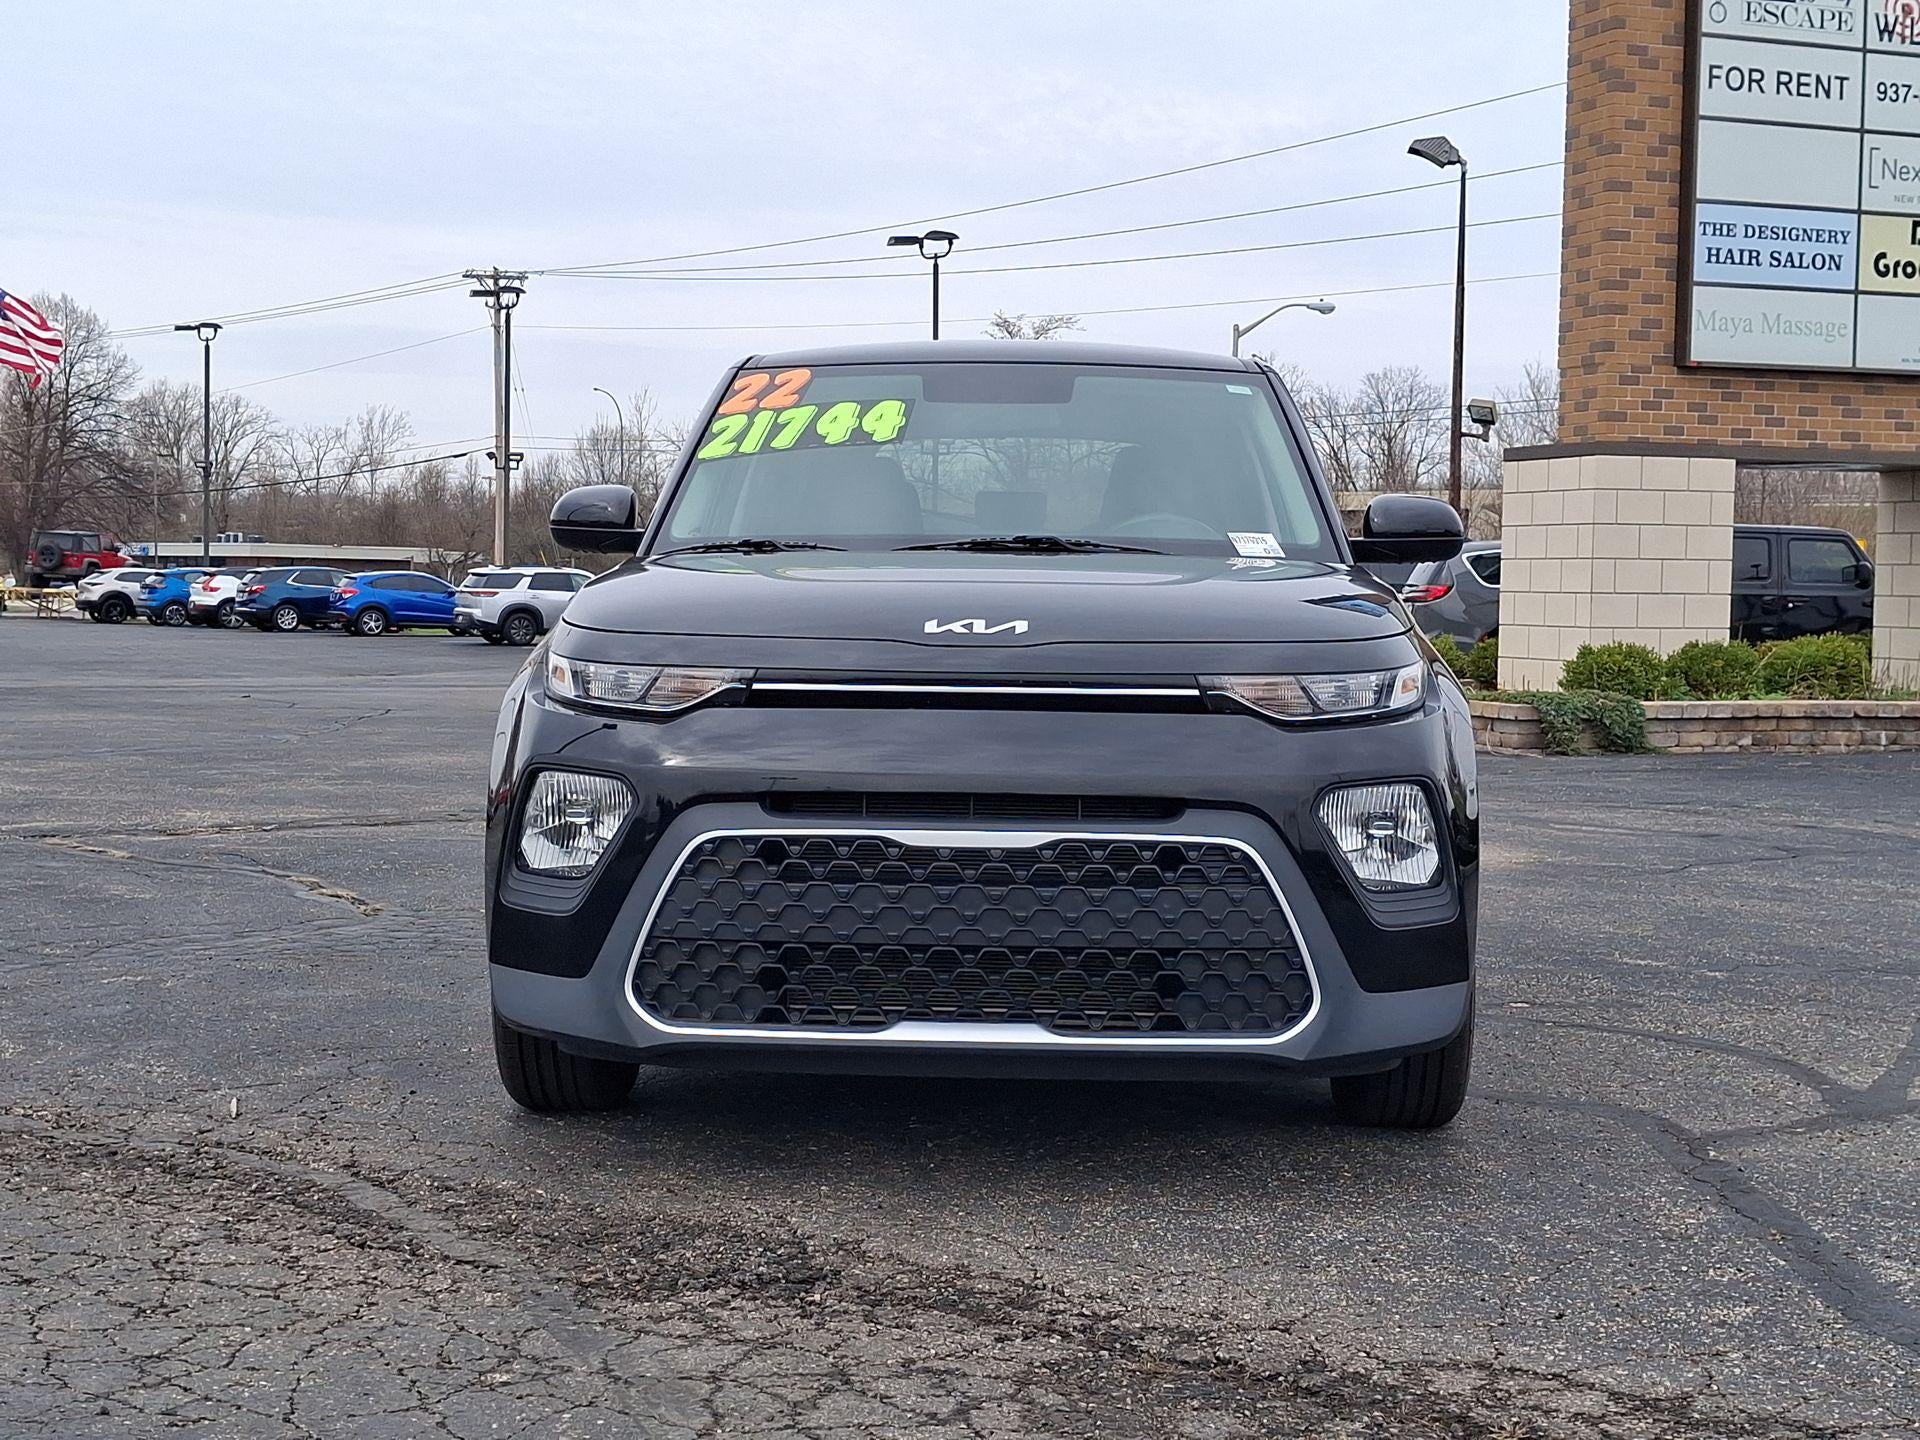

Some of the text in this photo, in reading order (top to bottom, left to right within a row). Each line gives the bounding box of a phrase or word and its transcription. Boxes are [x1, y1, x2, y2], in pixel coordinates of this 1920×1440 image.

[1745, 1, 1853, 32] ESCAPE
[1708, 64, 1850, 100] FOR RENT
[1699, 222, 1852, 245] THE DESIGNERY
[1705, 246, 1844, 271] HAIR SALON
[1874, 252, 1920, 279] Gro
[1695, 309, 1848, 343] Maya Massage
[718, 368, 812, 415] 22
[697, 400, 906, 460] 21744
[924, 619, 1029, 635] KIA
